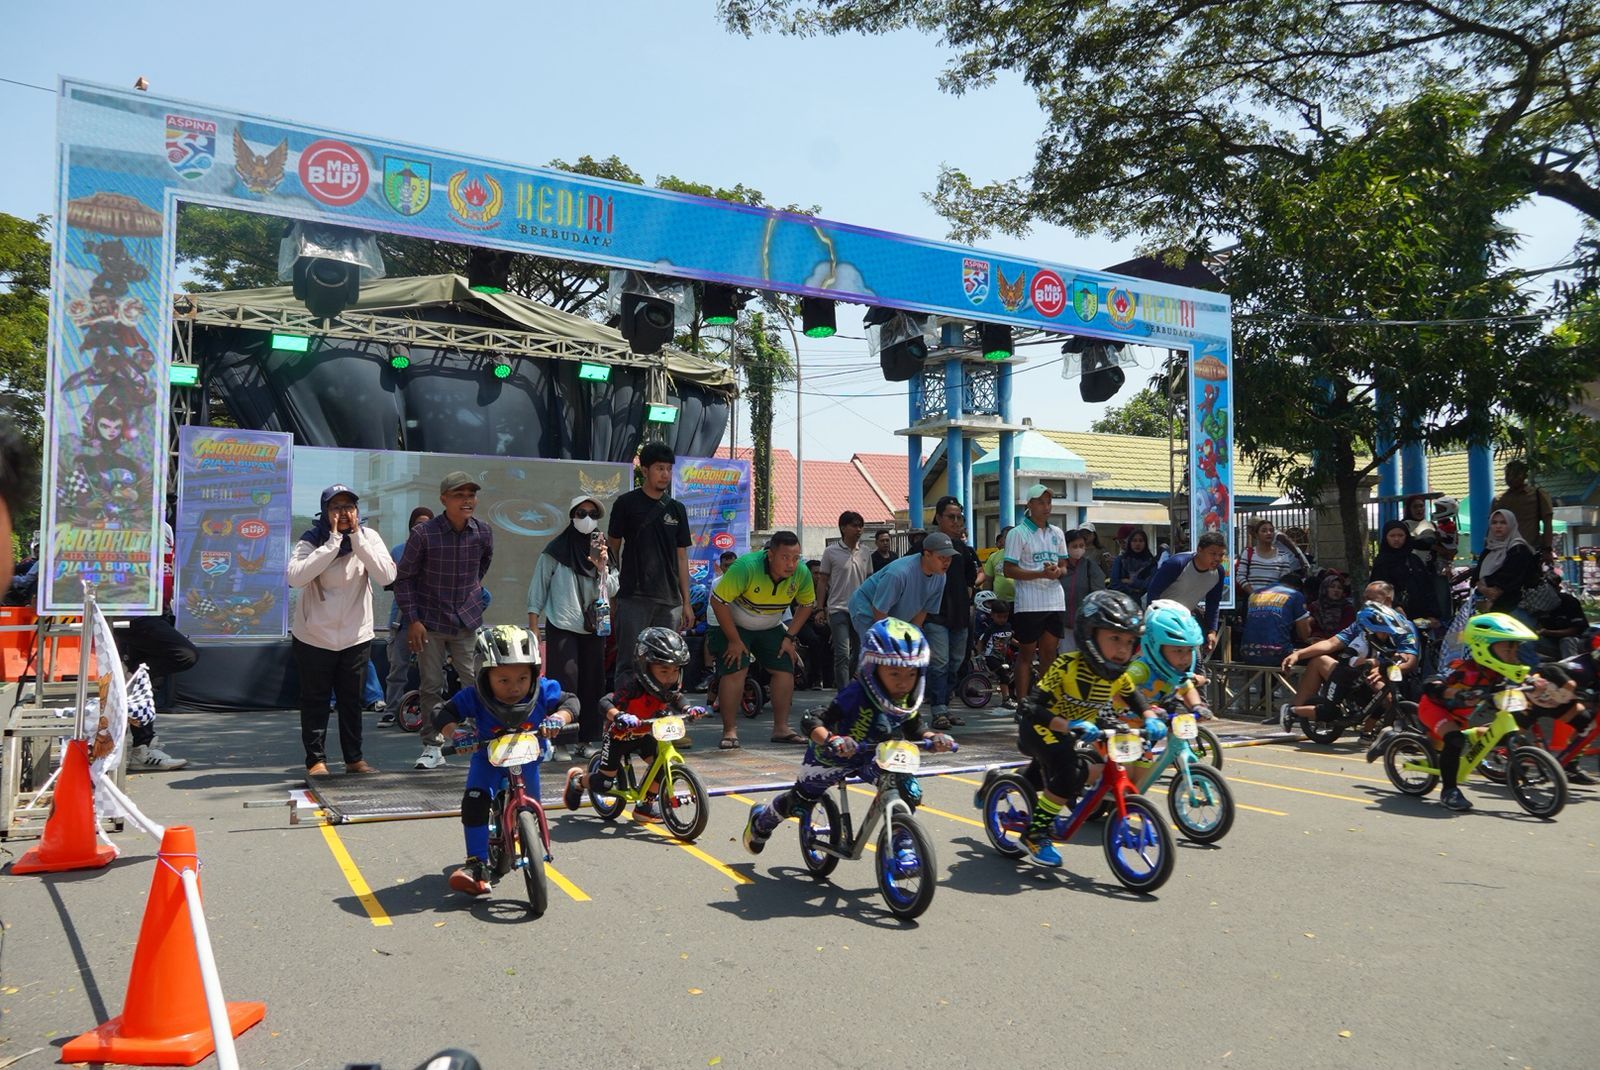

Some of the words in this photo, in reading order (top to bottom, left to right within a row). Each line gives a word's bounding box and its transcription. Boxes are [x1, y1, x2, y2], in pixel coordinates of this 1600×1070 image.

[167, 117, 216, 133] ASPINA
[327, 159, 359, 173] Mas
[308, 166, 358, 189] Bup
[516, 222, 612, 248] BERBUDAYA
[964, 259, 989, 270] ASPINA
[1035, 289, 1061, 304] Bup
[665, 725, 677, 734] 40
[849, 706, 874, 742] SHARK
[893, 753, 907, 764] 42
